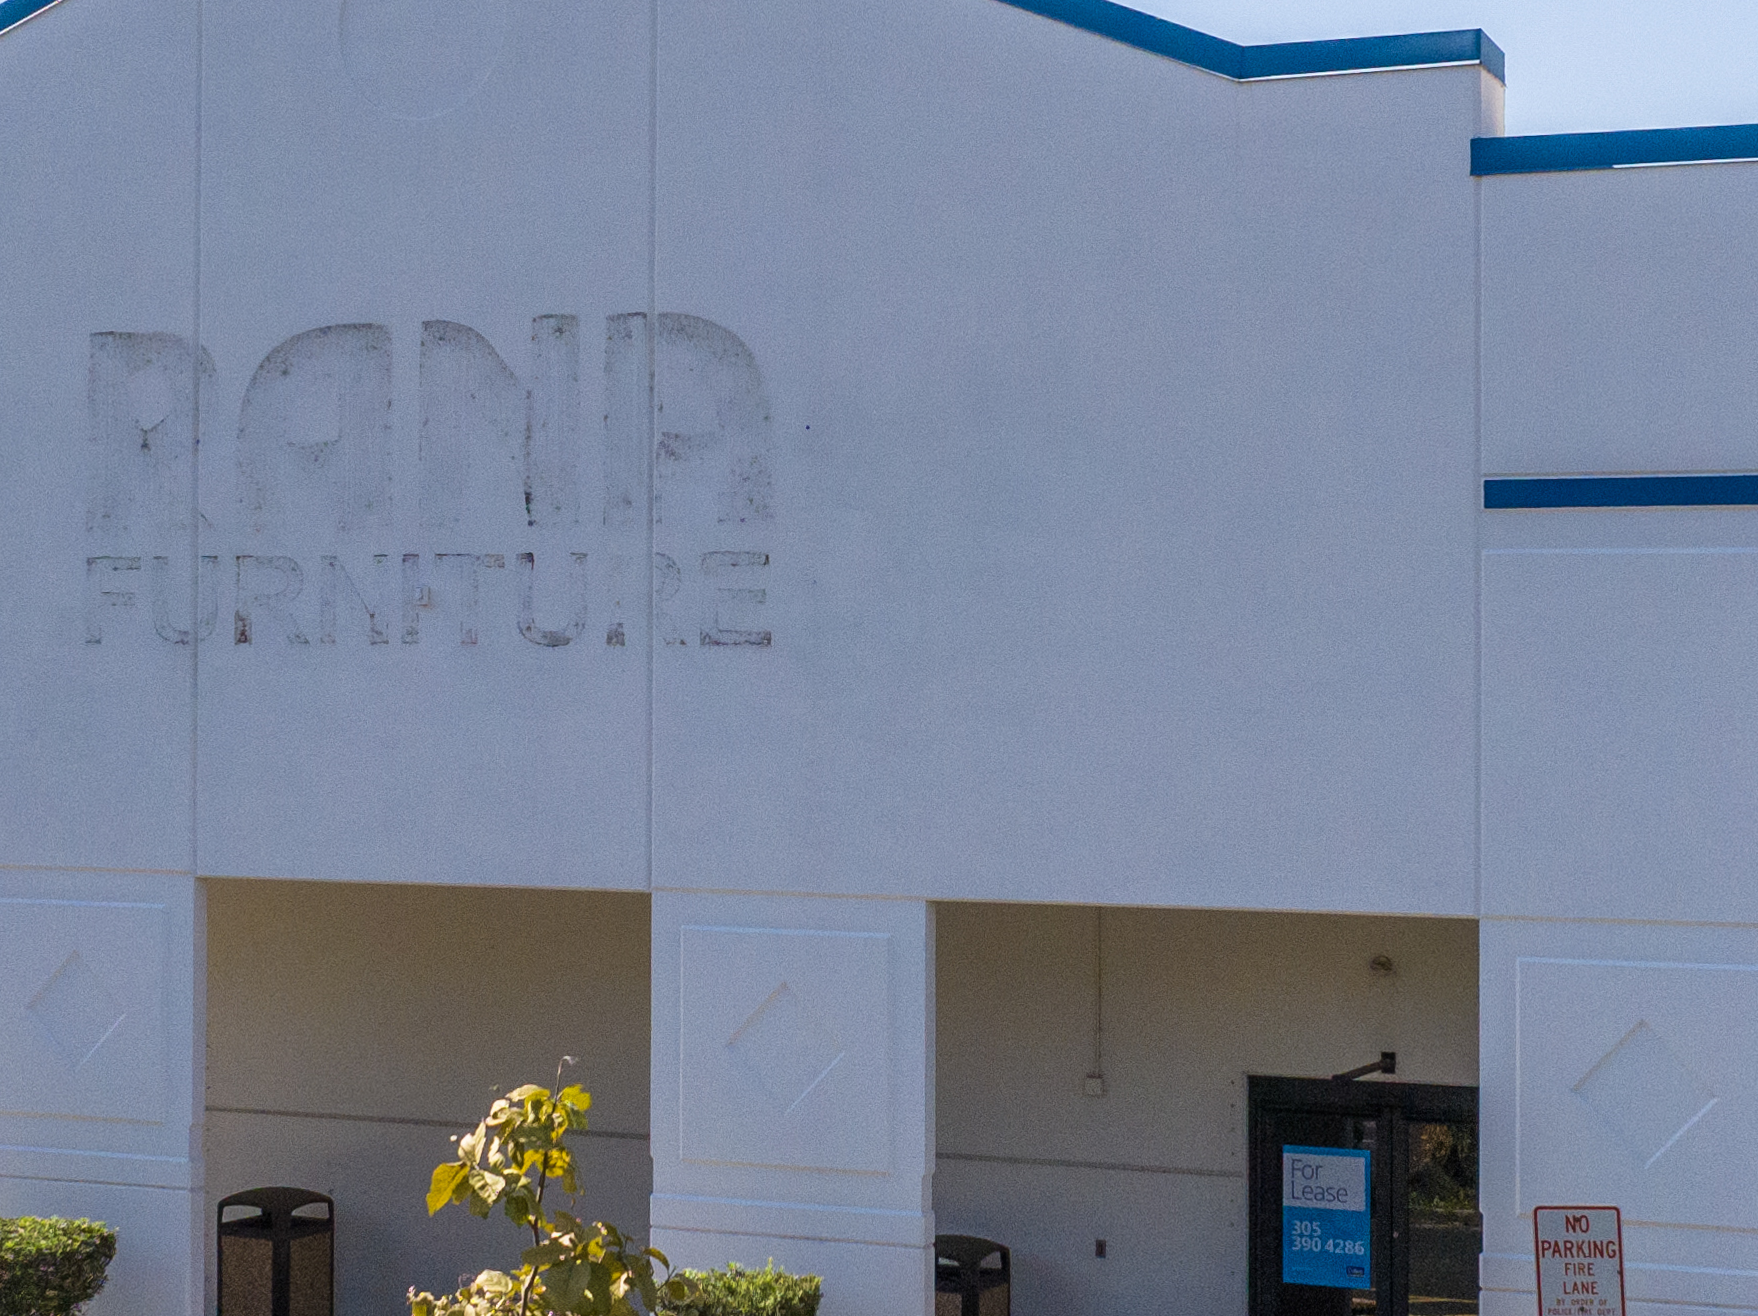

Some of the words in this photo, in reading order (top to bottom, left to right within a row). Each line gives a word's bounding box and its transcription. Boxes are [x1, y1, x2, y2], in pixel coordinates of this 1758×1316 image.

[1291, 1158, 1323, 1180] For
[1291, 1180, 1349, 1204] Lease
[1291, 1220, 1322, 1237] 305
[1565, 1214, 1590, 1234] NO
[1291, 1235, 1322, 1252] 390
[1324, 1238, 1365, 1256] 4286
[1540, 1239, 1617, 1259] PARKING
[1564, 1262, 1596, 1277] FIRE
[1563, 1281, 1599, 1296] LANE
[1556, 1297, 1565, 1306] BY
[1570, 1298, 1594, 1307] ORDER
[1598, 1298, 1608, 1307] OF
